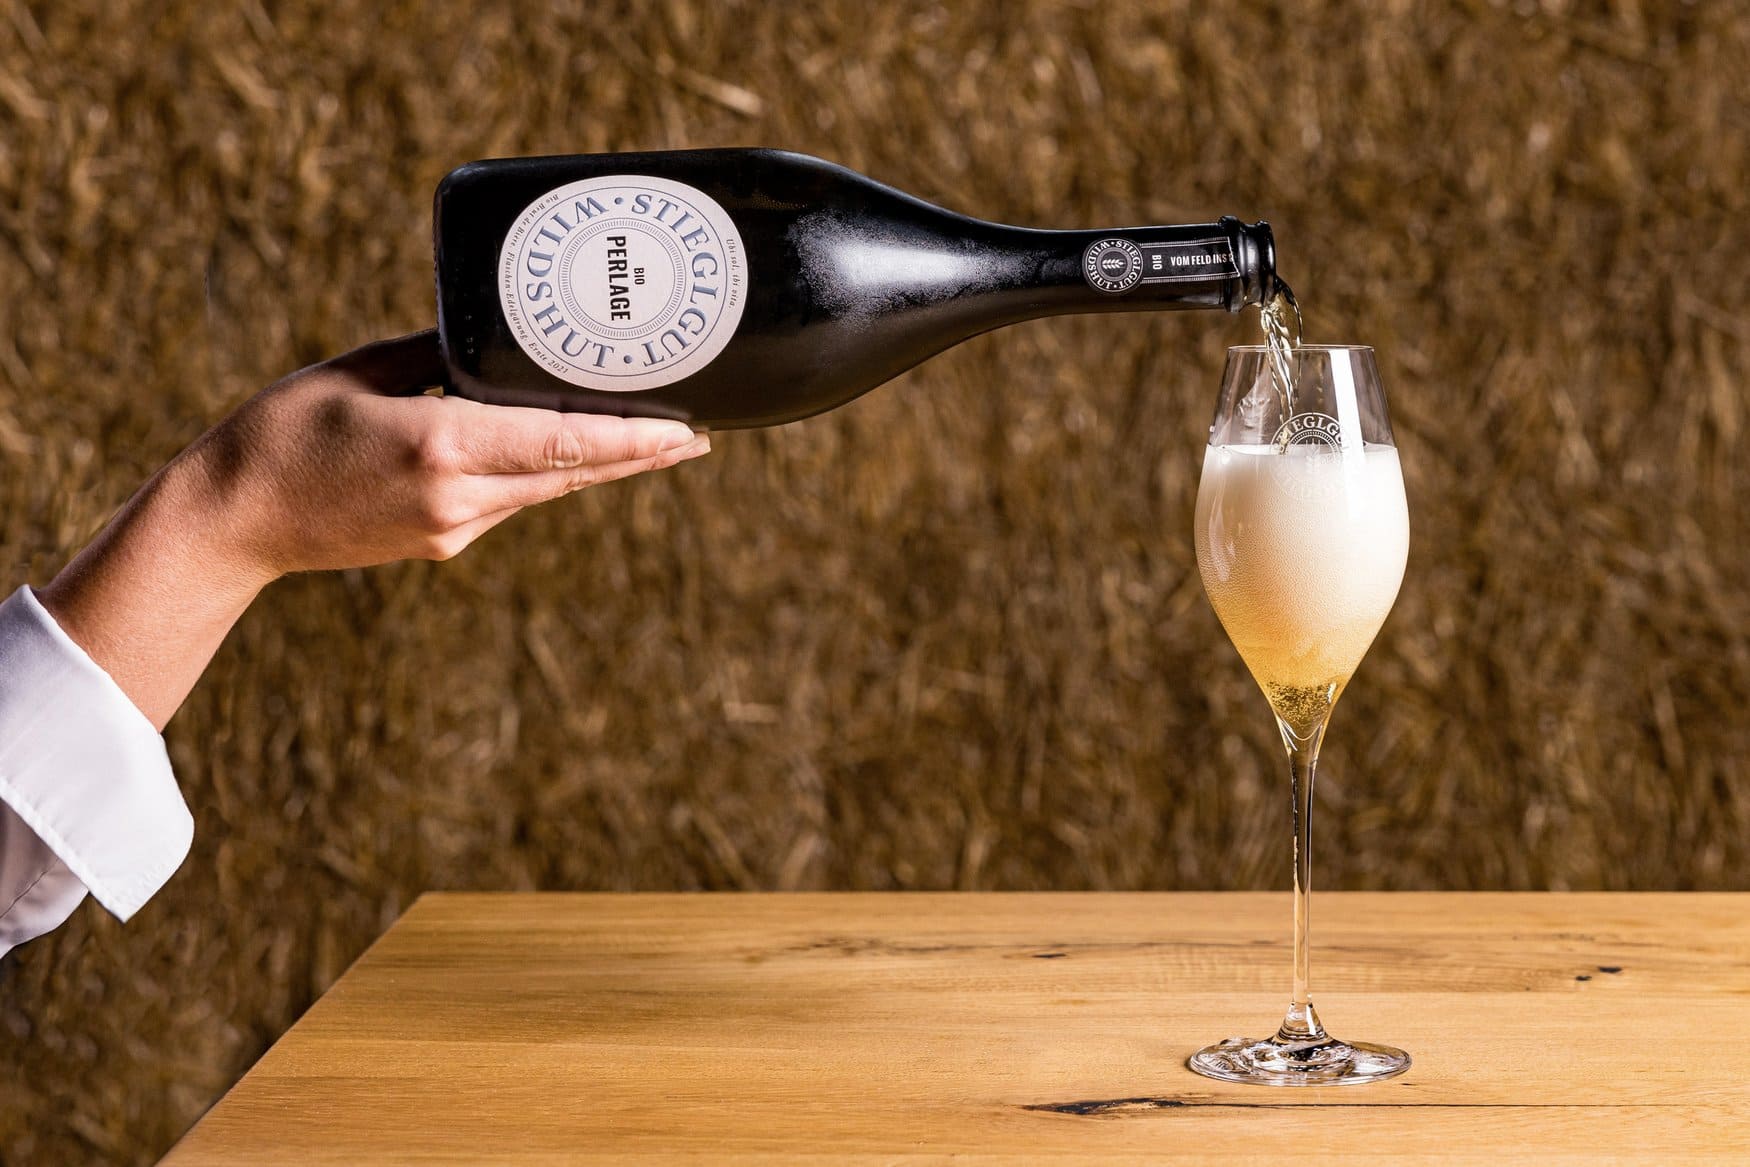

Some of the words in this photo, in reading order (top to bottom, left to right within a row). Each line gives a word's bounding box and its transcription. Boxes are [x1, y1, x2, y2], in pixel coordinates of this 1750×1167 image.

[526, 196, 615, 369] WILDSHUT
[606, 235, 631, 321] PERLAGE
[631, 193, 719, 367] STIEGLGUT
[633, 267, 645, 285] BIO
[1087, 241, 1113, 289] WILDSHUT
[1115, 240, 1141, 289] STIEGLGUT
[1151, 254, 1163, 270] BIO
[1170, 255, 1190, 266] VOM
[1191, 254, 1211, 266] FELD
[1212, 253, 1228, 264] INS
[528, 342, 547, 360] Ernte
